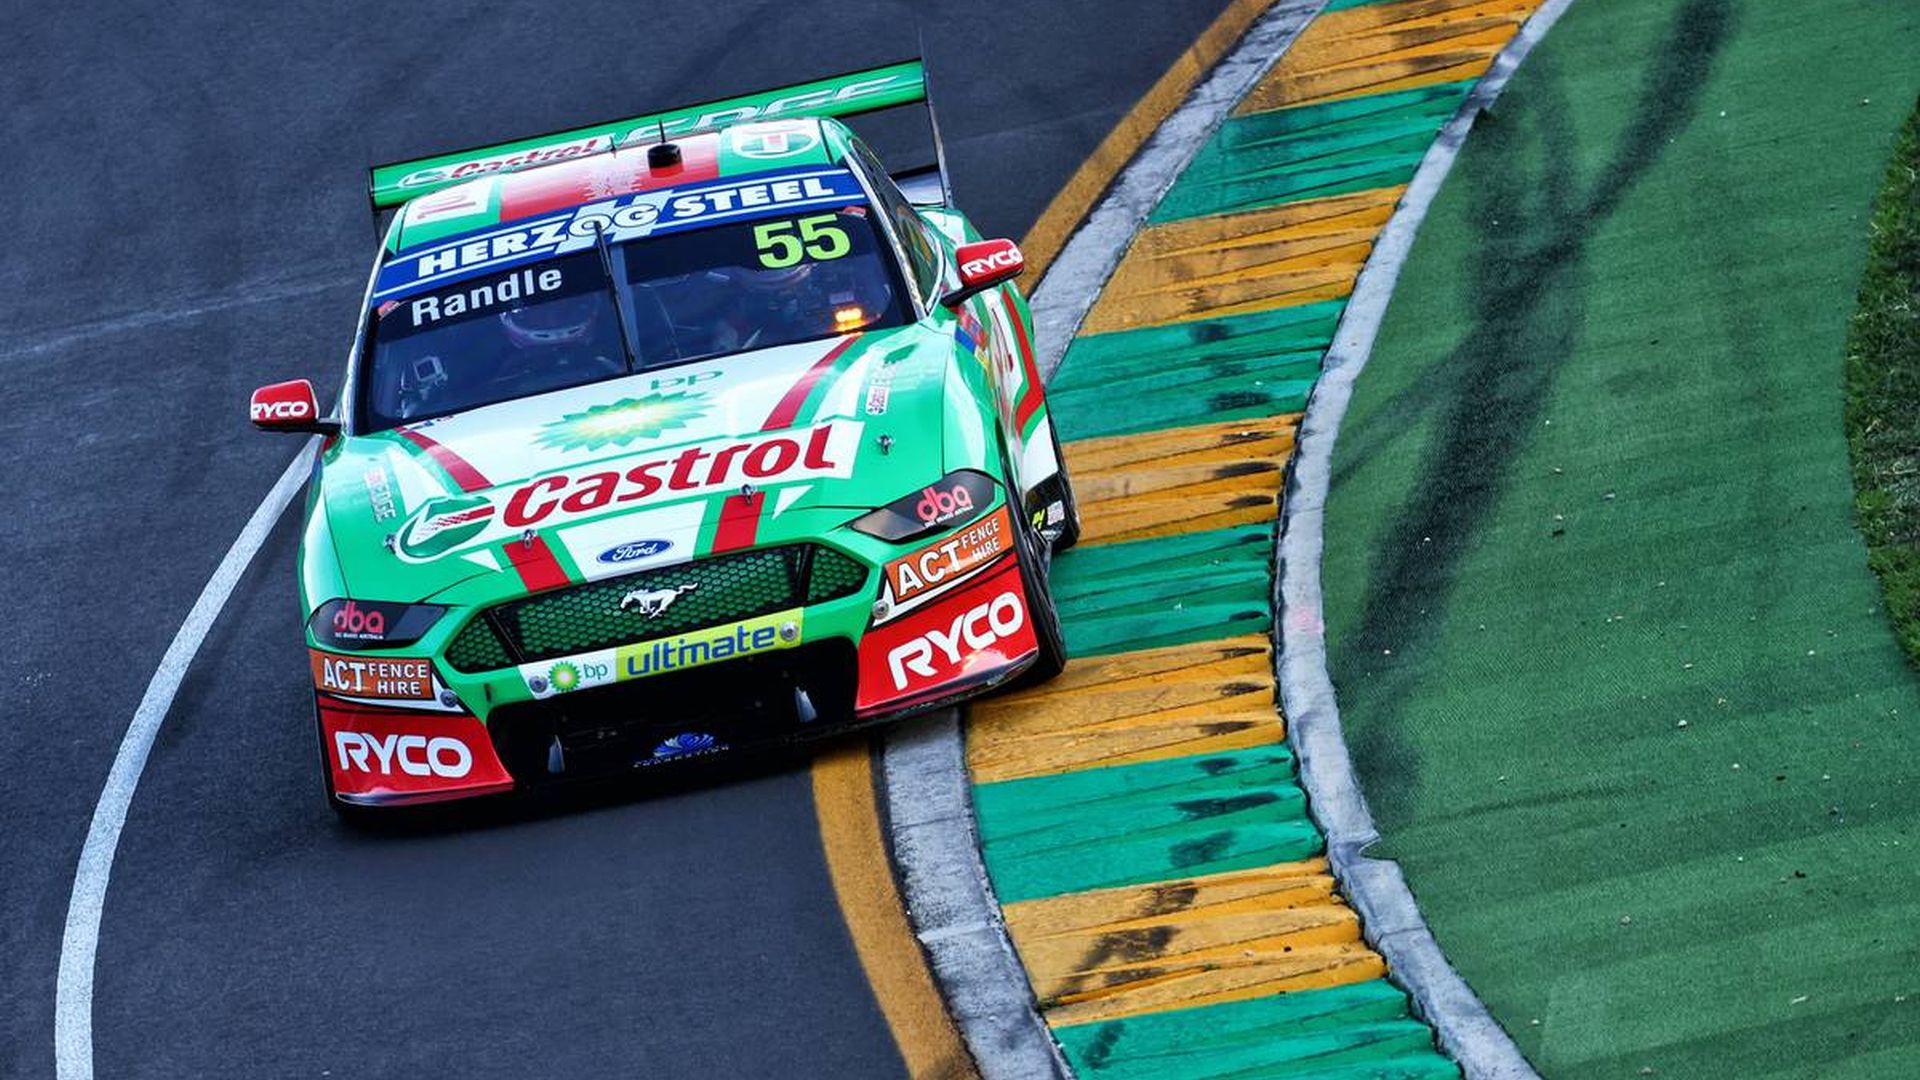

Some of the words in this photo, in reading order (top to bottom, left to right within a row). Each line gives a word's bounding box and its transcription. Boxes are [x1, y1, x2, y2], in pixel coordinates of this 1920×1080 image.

[450, 139, 598, 178] Castrol
[417, 203, 660, 278] HERZOG
[672, 178, 835, 217] STEEL
[753, 213, 851, 269] 55
[961, 247, 1024, 277] RYCO
[411, 268, 563, 327] Randle
[650, 370, 724, 390] bp
[502, 424, 836, 528] Castrol
[917, 484, 973, 522] dba
[611, 542, 659, 561] Ford
[960, 517, 1000, 549] FENCE
[970, 536, 1000, 563] HIRE
[896, 539, 962, 597] ACT
[334, 600, 385, 634] dba
[583, 662, 608, 679] bp
[627, 625, 776, 677] ultimate
[887, 591, 1024, 691] RYCO
[323, 657, 367, 693] ACT
[367, 662, 429, 679] FENCE
[377, 681, 421, 696] HIRE
[334, 731, 473, 778] RYCO
